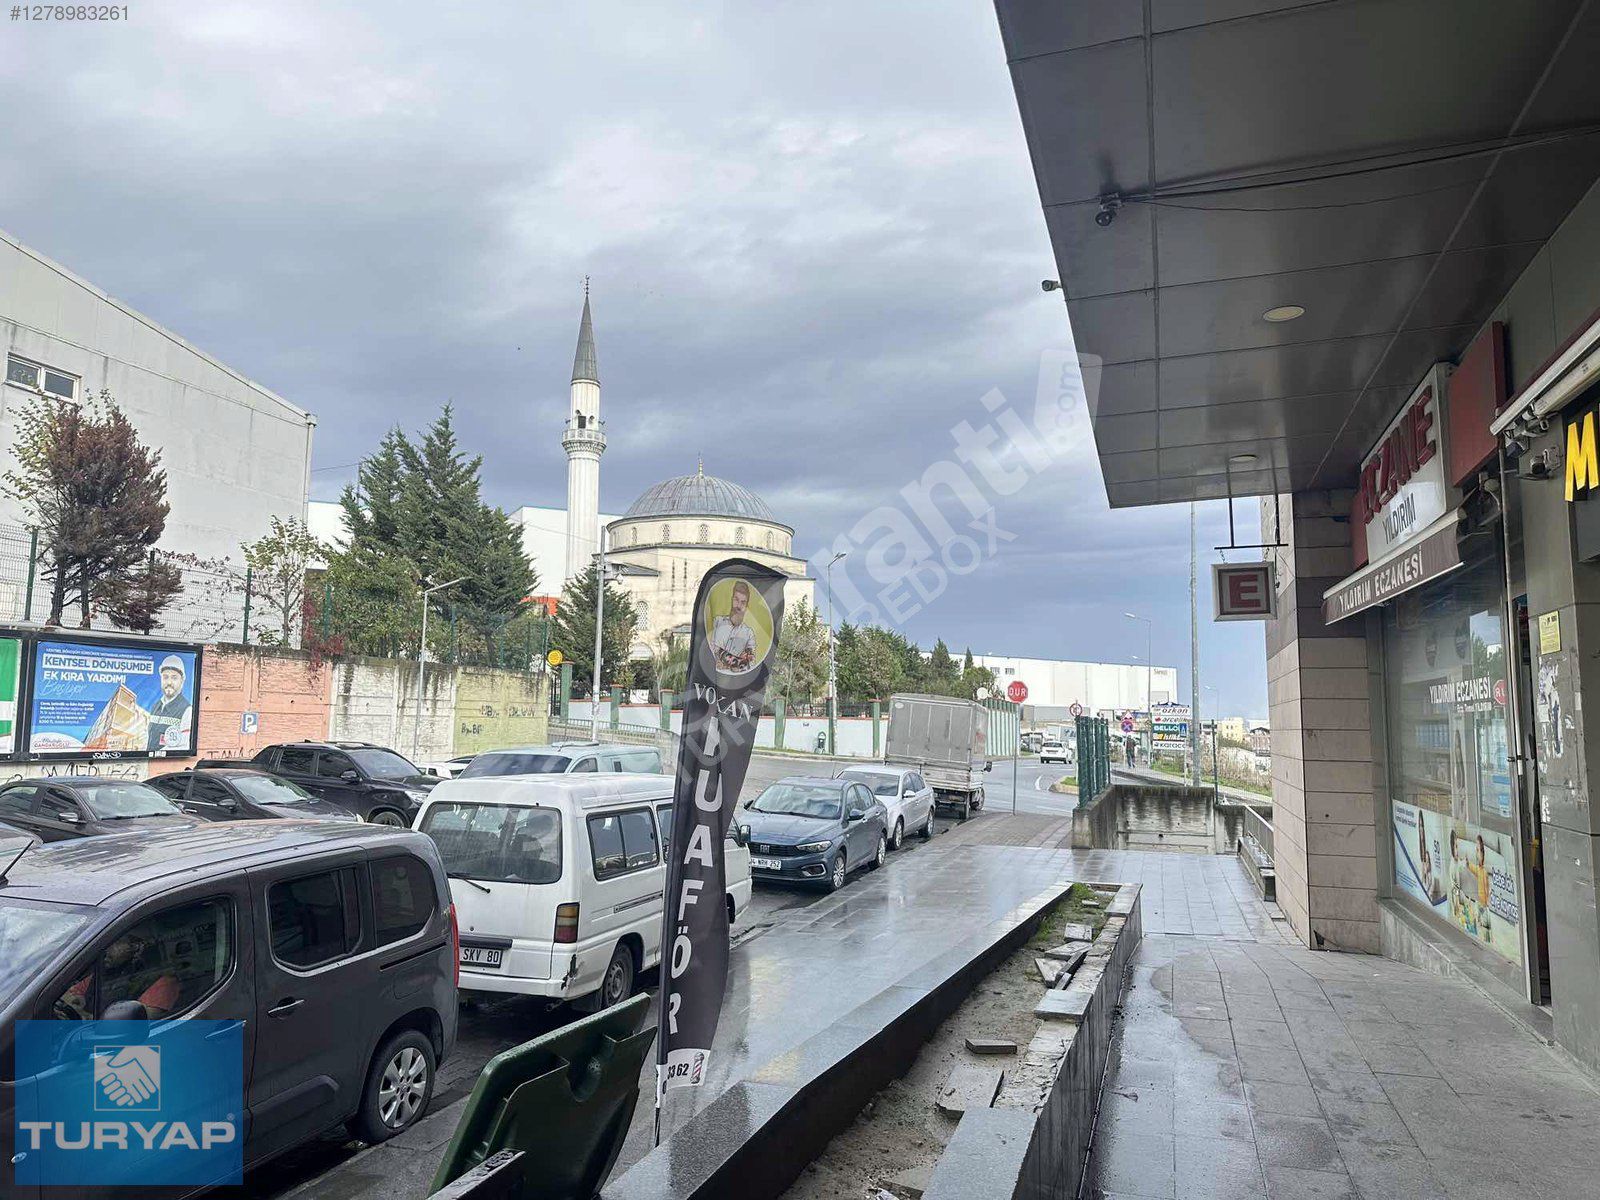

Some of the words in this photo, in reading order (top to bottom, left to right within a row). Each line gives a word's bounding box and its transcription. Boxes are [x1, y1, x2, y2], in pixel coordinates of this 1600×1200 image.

[1361, 384, 1436, 524] ECZANE
[1383, 493, 1416, 544] YILDIRIM
[1229, 575, 1261, 608] E
[1340, 580, 1371, 612] YILDIRIM
[44, 656, 90, 668] KENTSEL
[43, 671, 58, 681] EK
[1008, 687, 1026, 697] DUR
[1430, 683, 1455, 704] YILDIRIM
[1456, 671, 1491, 702] ECZANESİ
[245, 714, 254, 731] P
[487, 950, 500, 963] 80
[676, 1063, 689, 1076] 62
